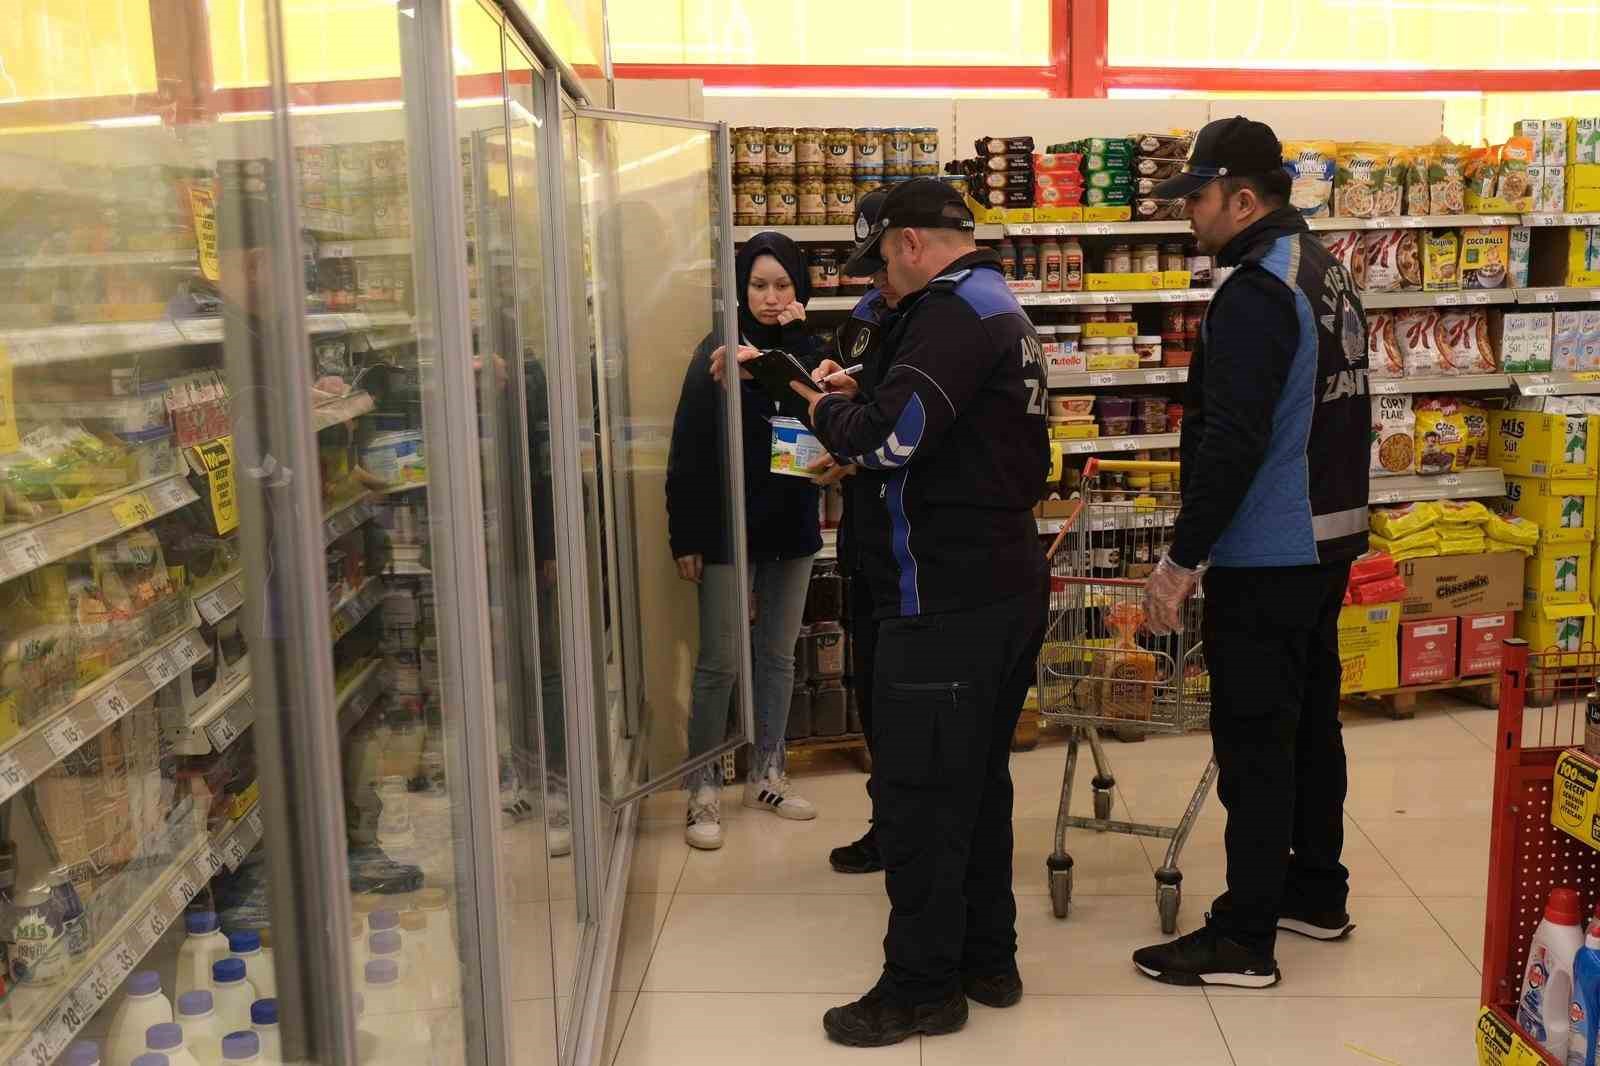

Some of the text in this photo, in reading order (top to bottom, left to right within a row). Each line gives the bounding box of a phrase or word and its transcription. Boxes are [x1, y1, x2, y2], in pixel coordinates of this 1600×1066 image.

[833, 146, 845, 154] Lio
[863, 145, 874, 154] Lio
[1051, 357, 1081, 365] nutella
[1380, 396, 1406, 409] CORN
[1504, 439, 1517, 452] Süt
